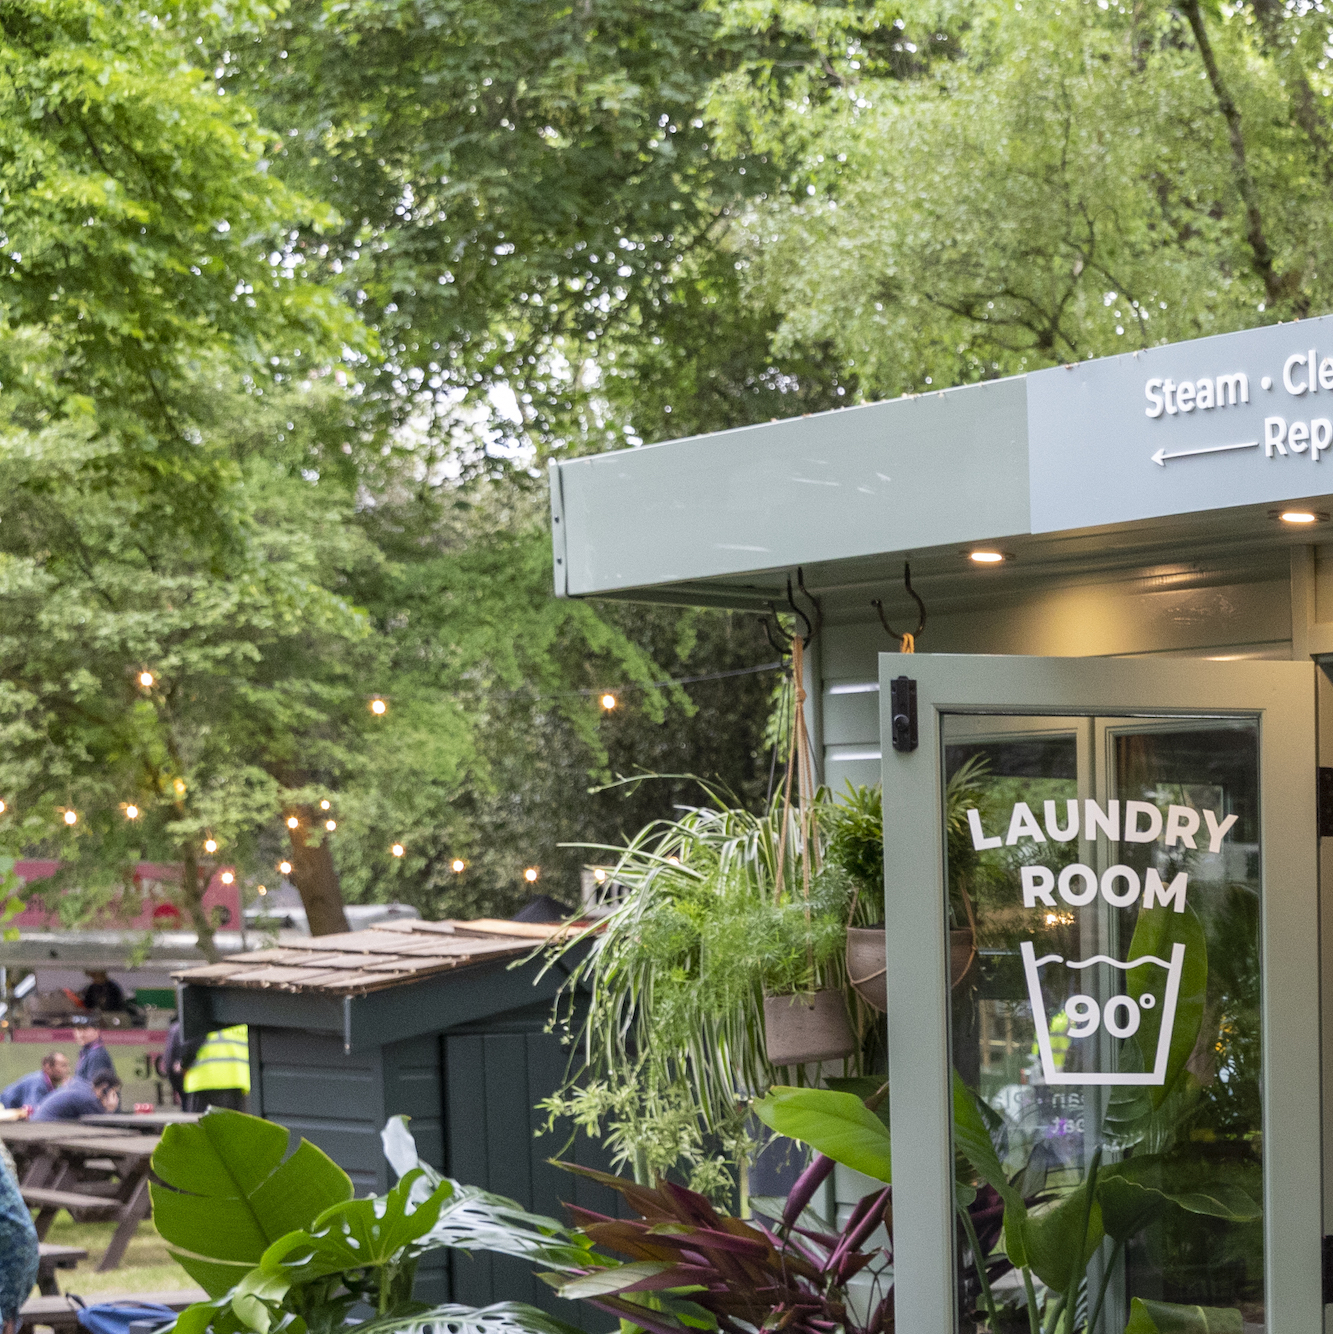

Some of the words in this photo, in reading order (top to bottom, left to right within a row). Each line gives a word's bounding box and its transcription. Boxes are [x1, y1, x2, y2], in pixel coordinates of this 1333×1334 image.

[1145, 372, 1249, 418] Steam
[967, 799, 1239, 853] LAUNDRY
[1020, 863, 1188, 914] ROOM
[1064, 993, 1156, 1038] 90°
